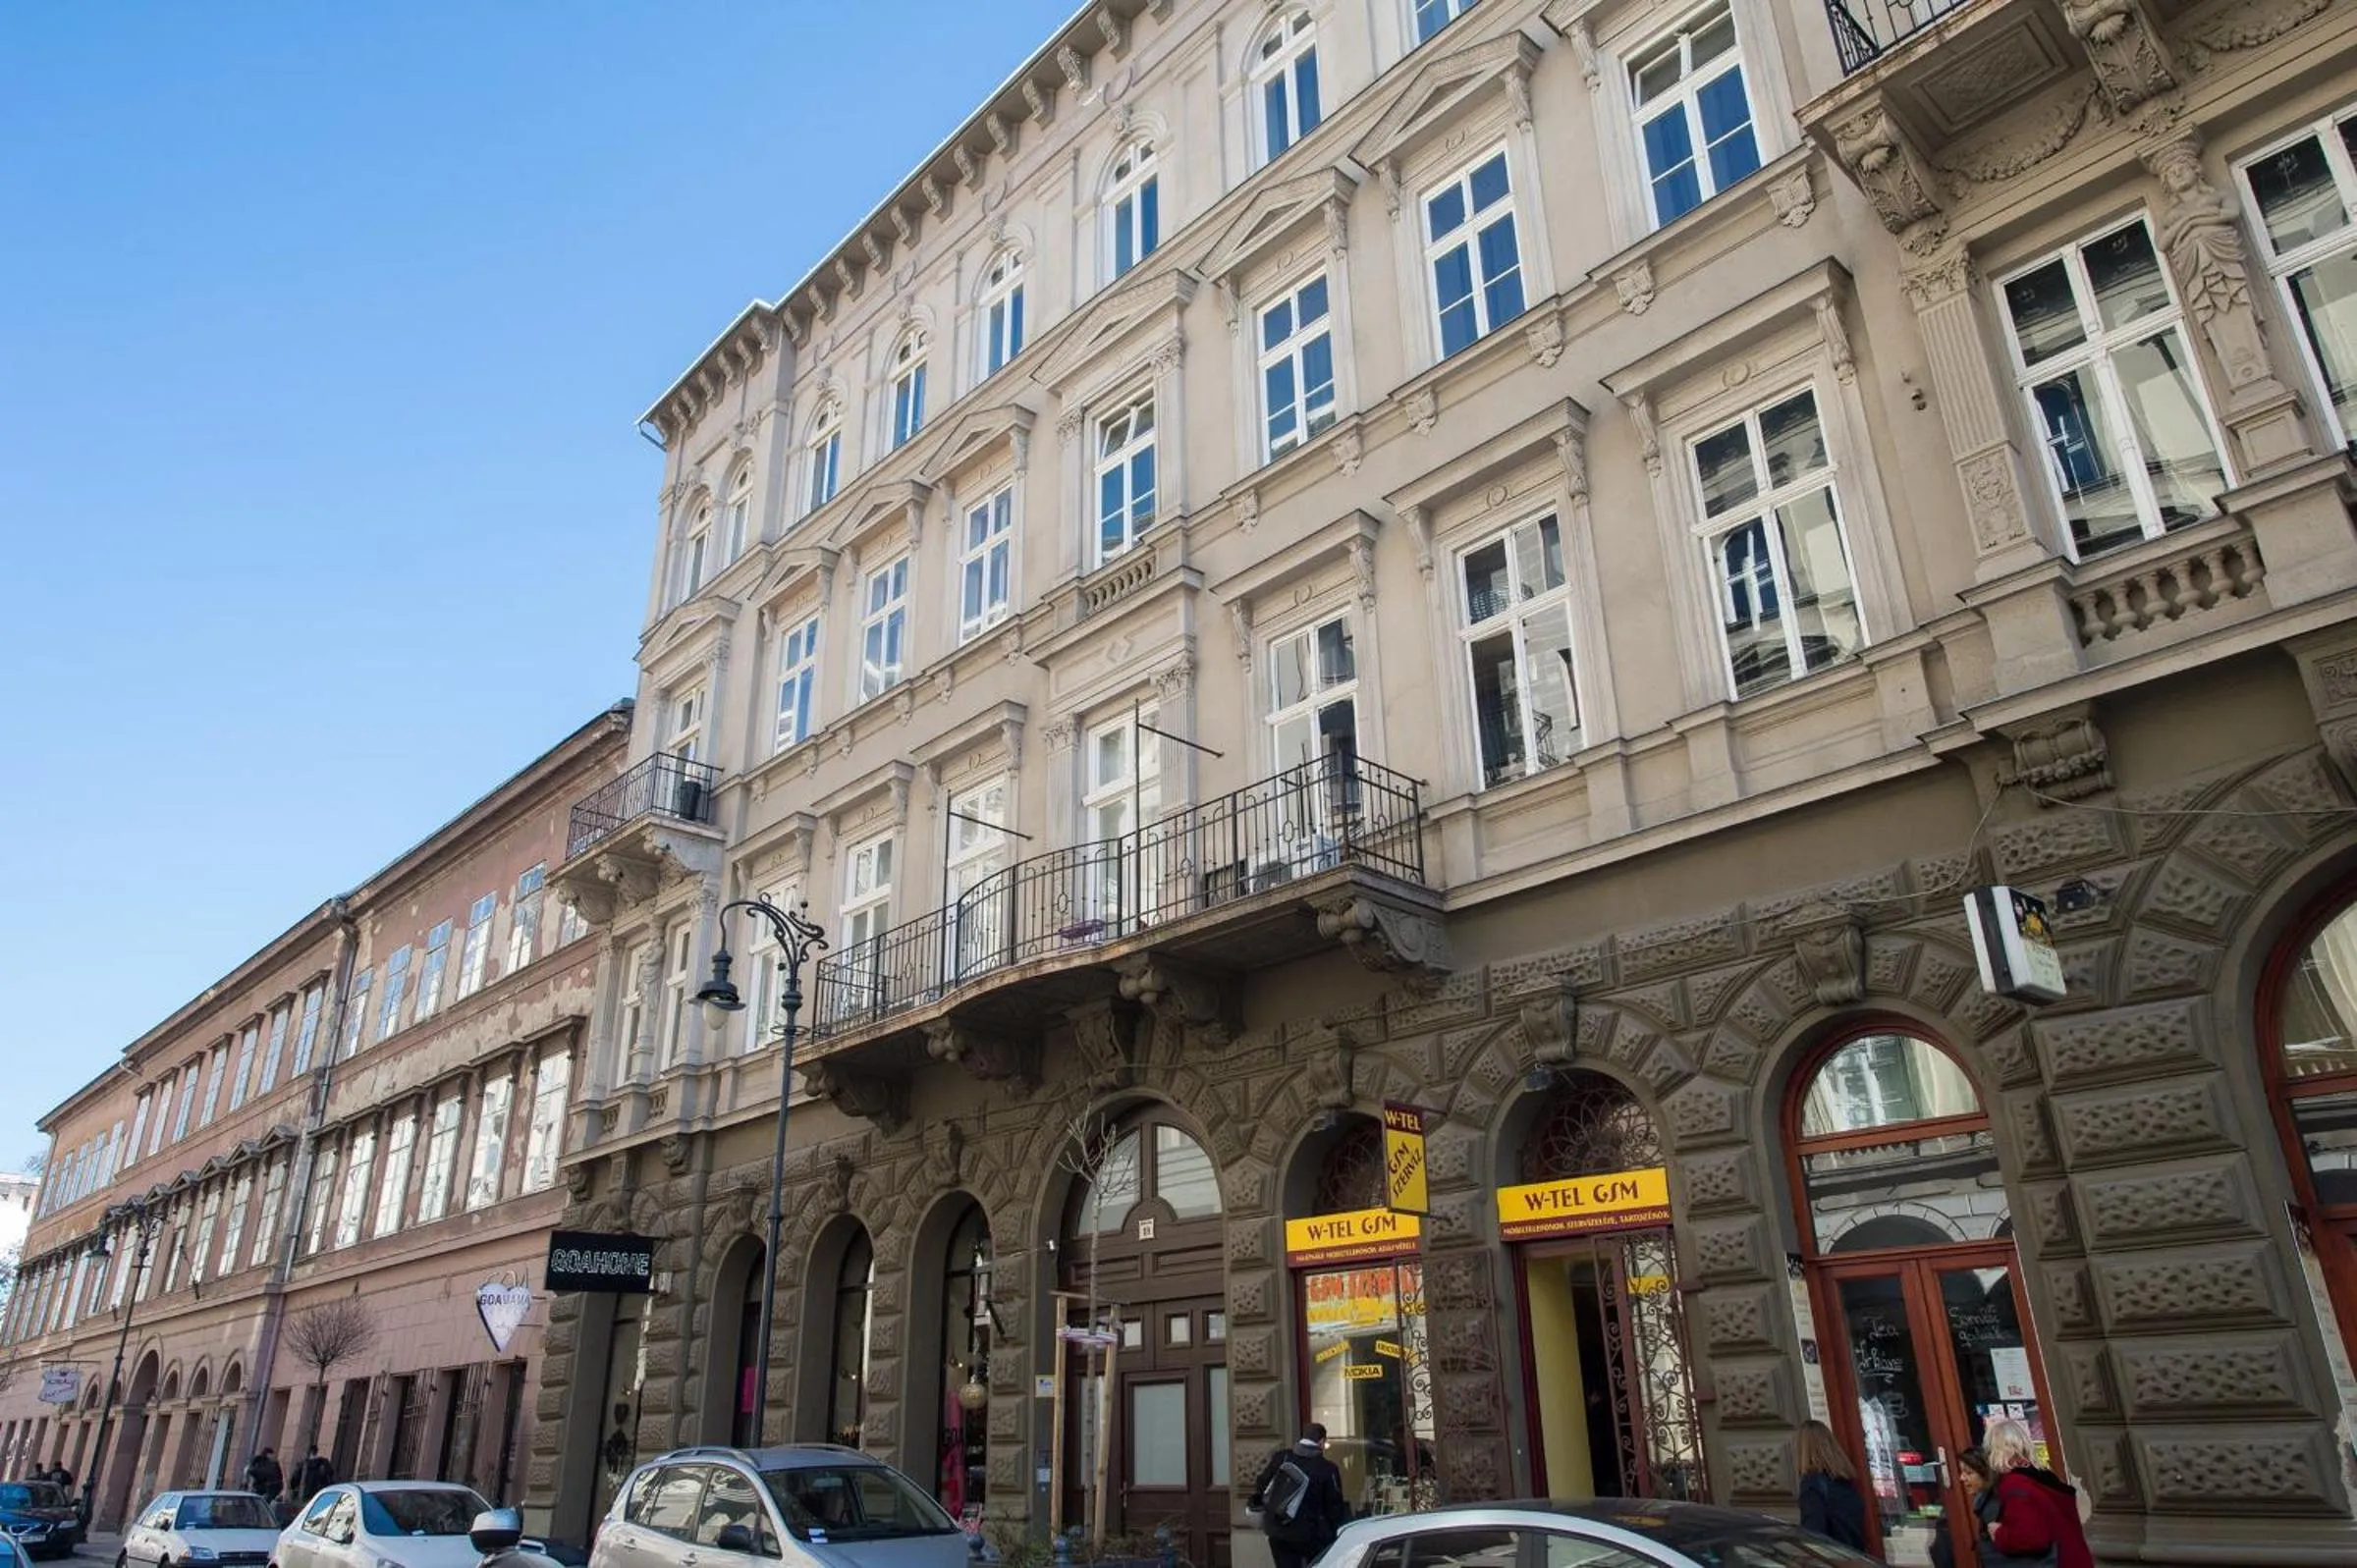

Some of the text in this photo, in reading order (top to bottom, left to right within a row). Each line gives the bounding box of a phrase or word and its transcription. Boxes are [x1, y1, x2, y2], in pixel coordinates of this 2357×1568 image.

[1384, 1109, 1421, 1131] W-TEL
[1388, 1140, 1410, 1174] GSM
[1393, 1147, 1423, 1198] SZERVIZ
[1524, 1179, 1639, 1212] W-TEL GSM
[1307, 1215, 1397, 1241] W-TEL GSM
[551, 1248, 649, 1275] GOAHOME
[1344, 1367, 1380, 1377] NOKIA
